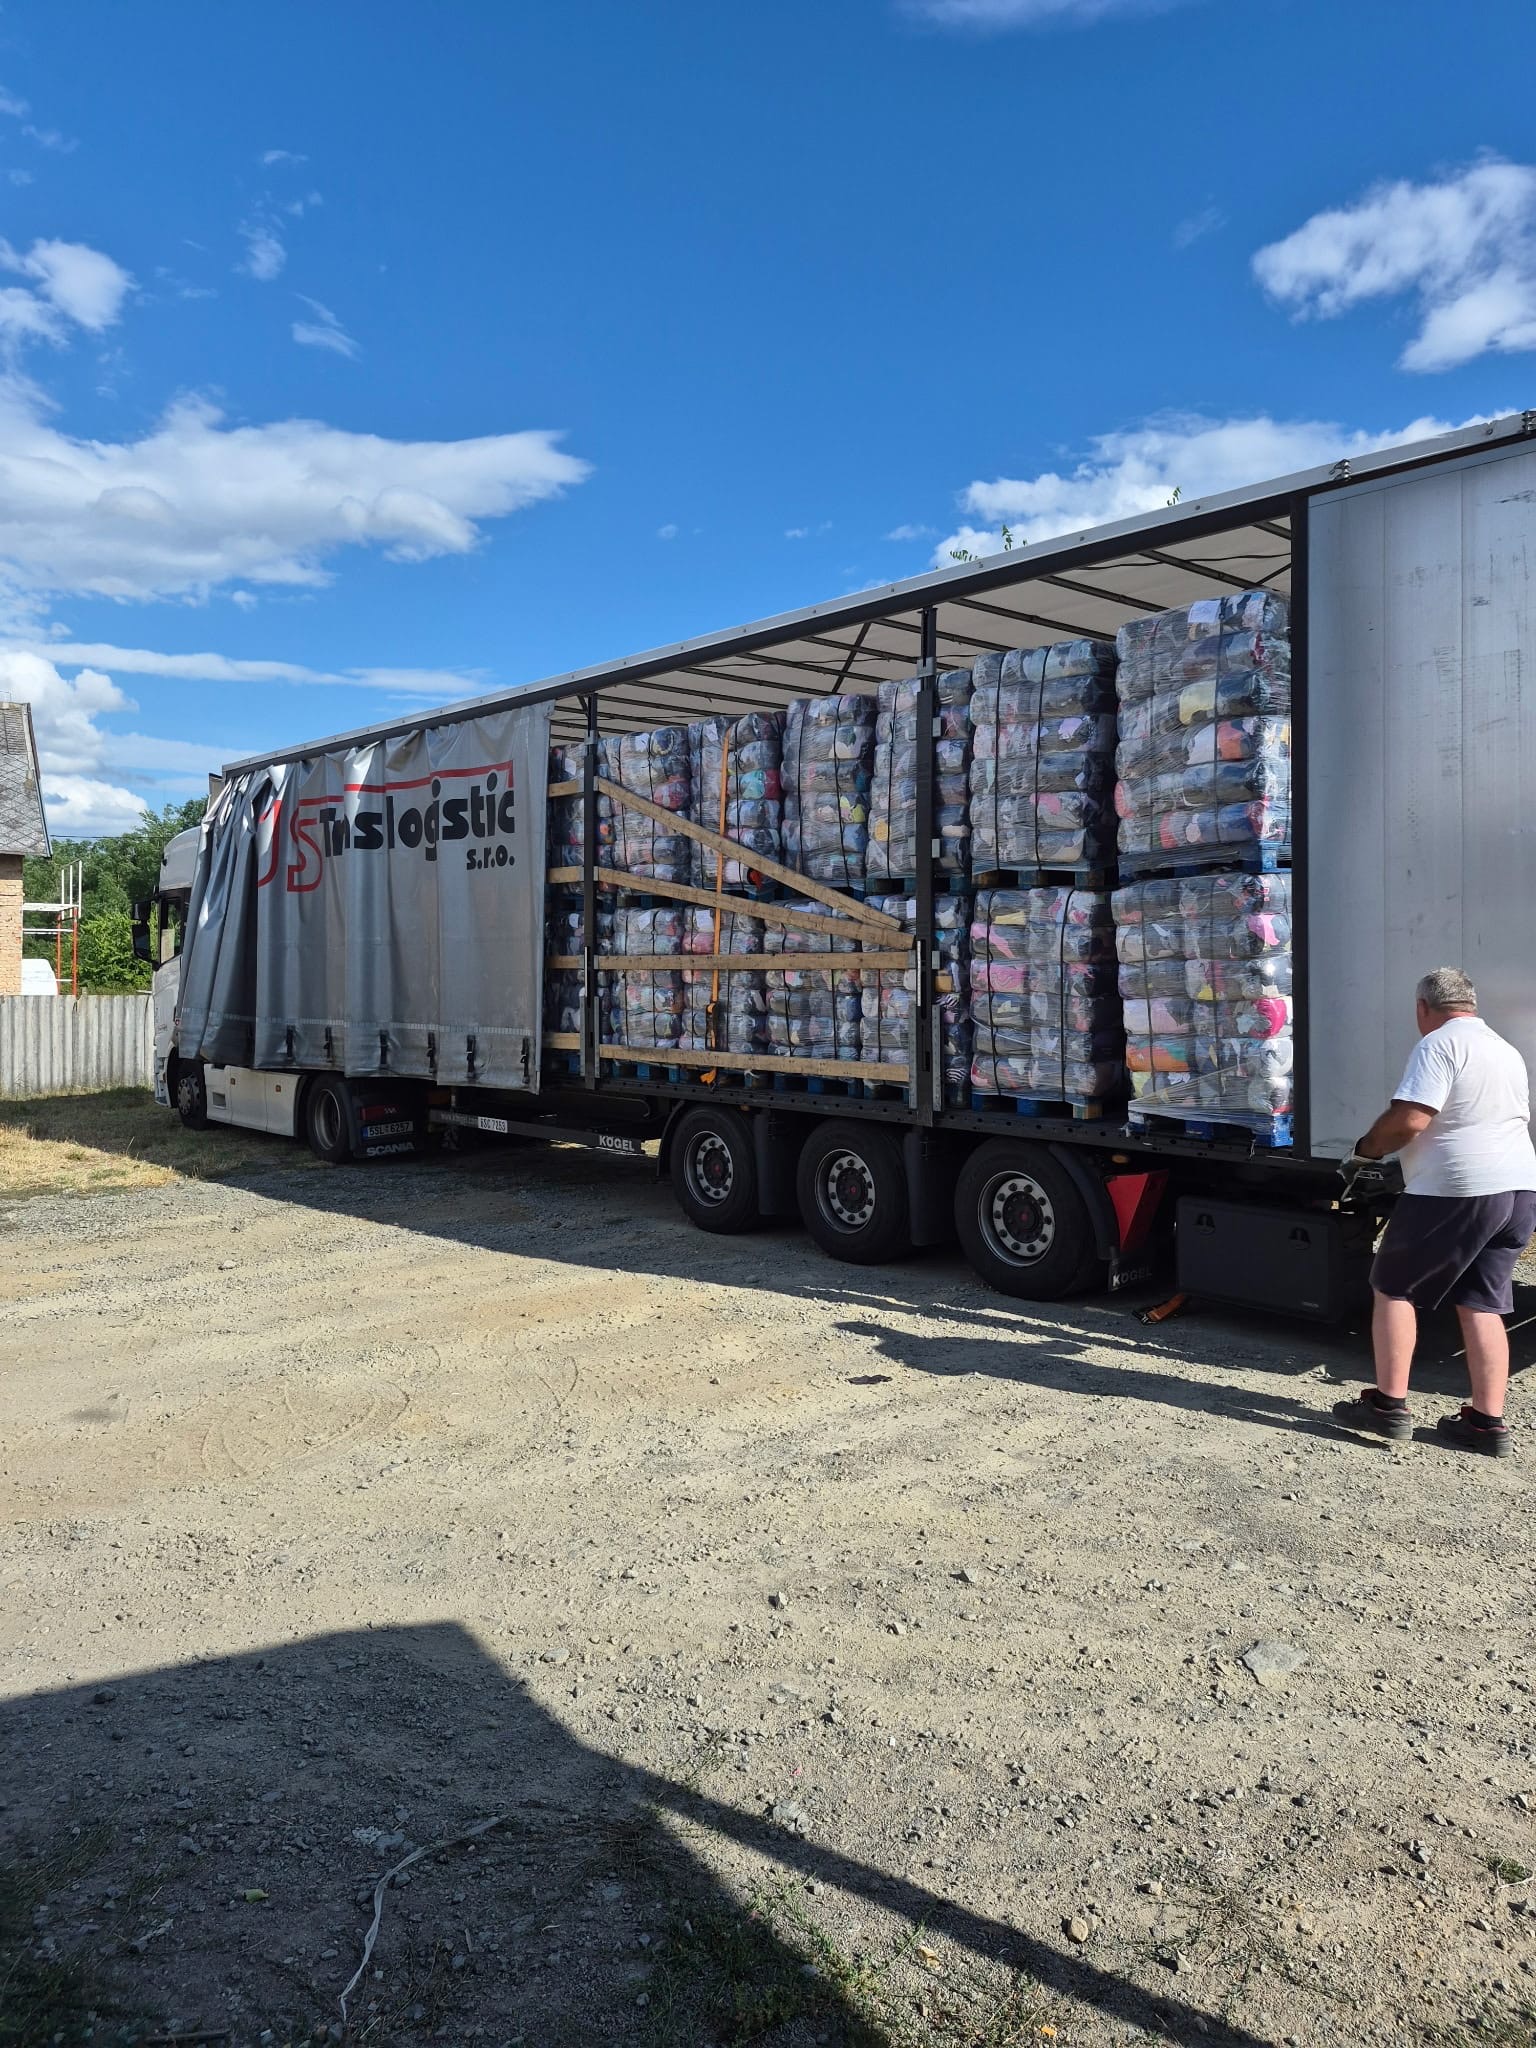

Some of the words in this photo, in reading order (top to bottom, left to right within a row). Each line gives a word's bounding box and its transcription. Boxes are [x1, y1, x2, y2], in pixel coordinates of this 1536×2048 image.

[319, 771, 516, 862] Tnslogistic
[466, 844, 516, 871] s.r.o.
[366, 1141, 415, 1157] SCANIA
